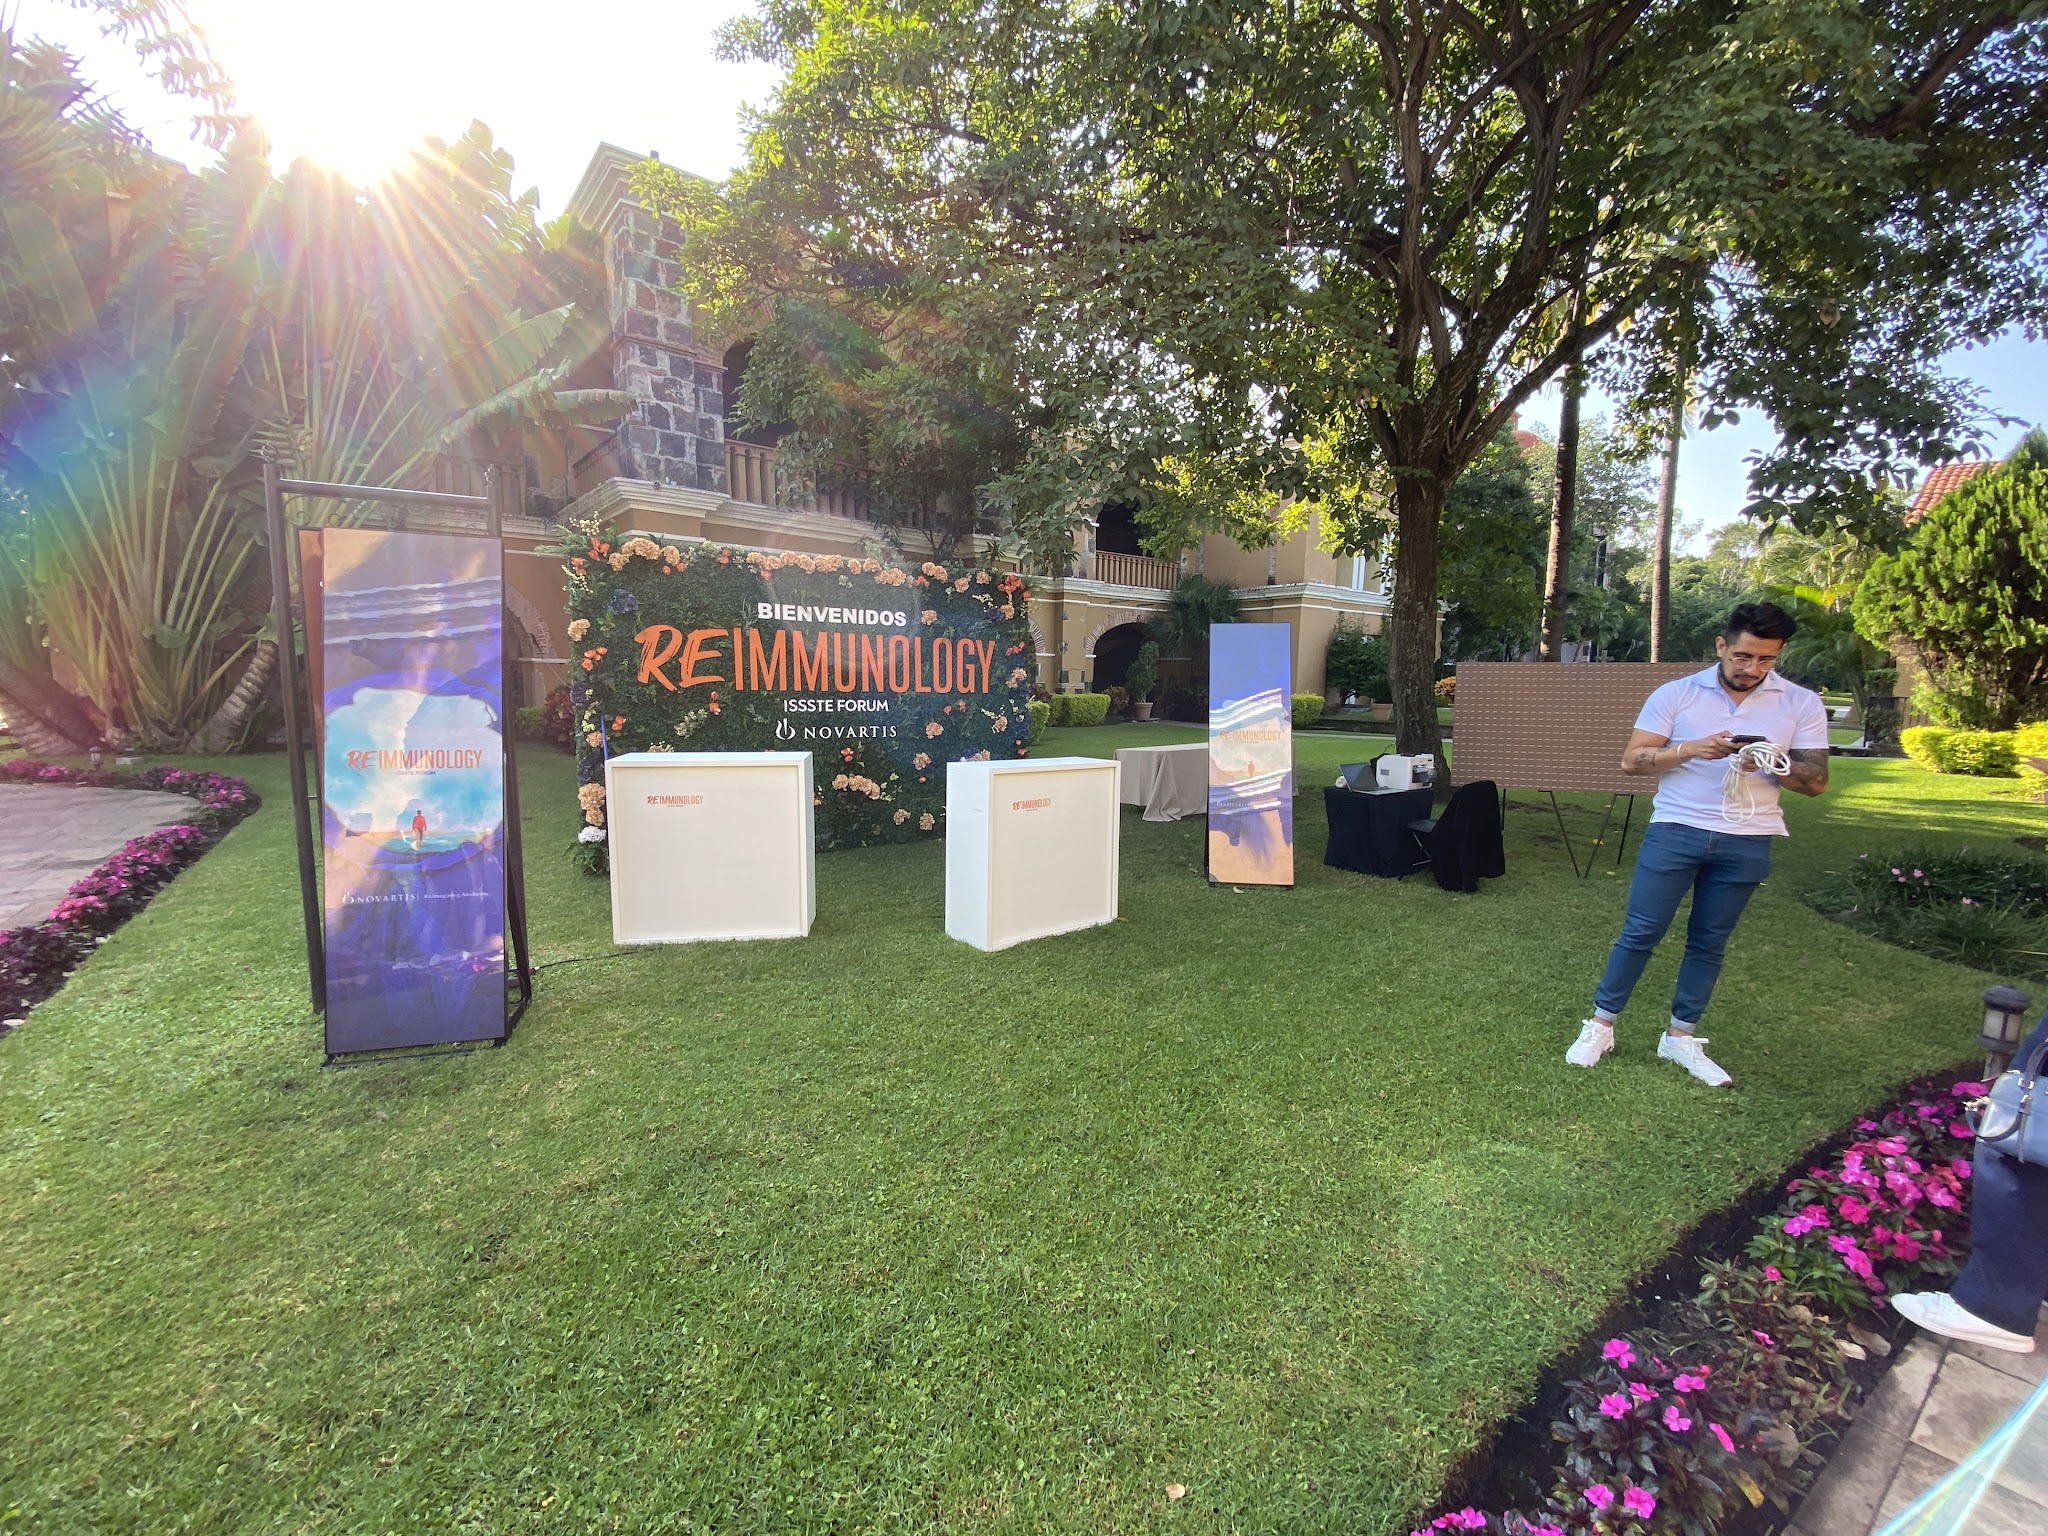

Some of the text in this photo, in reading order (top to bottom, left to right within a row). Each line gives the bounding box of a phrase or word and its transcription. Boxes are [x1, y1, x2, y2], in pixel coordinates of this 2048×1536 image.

[757, 602, 907, 627] BIENVENIDOS
[634, 624, 996, 692] REIMMUNOLOGY
[783, 699, 889, 712] ISSSTE FORUM
[804, 725, 898, 739] NOVARTIS
[356, 893, 416, 904] NOVARTIS
